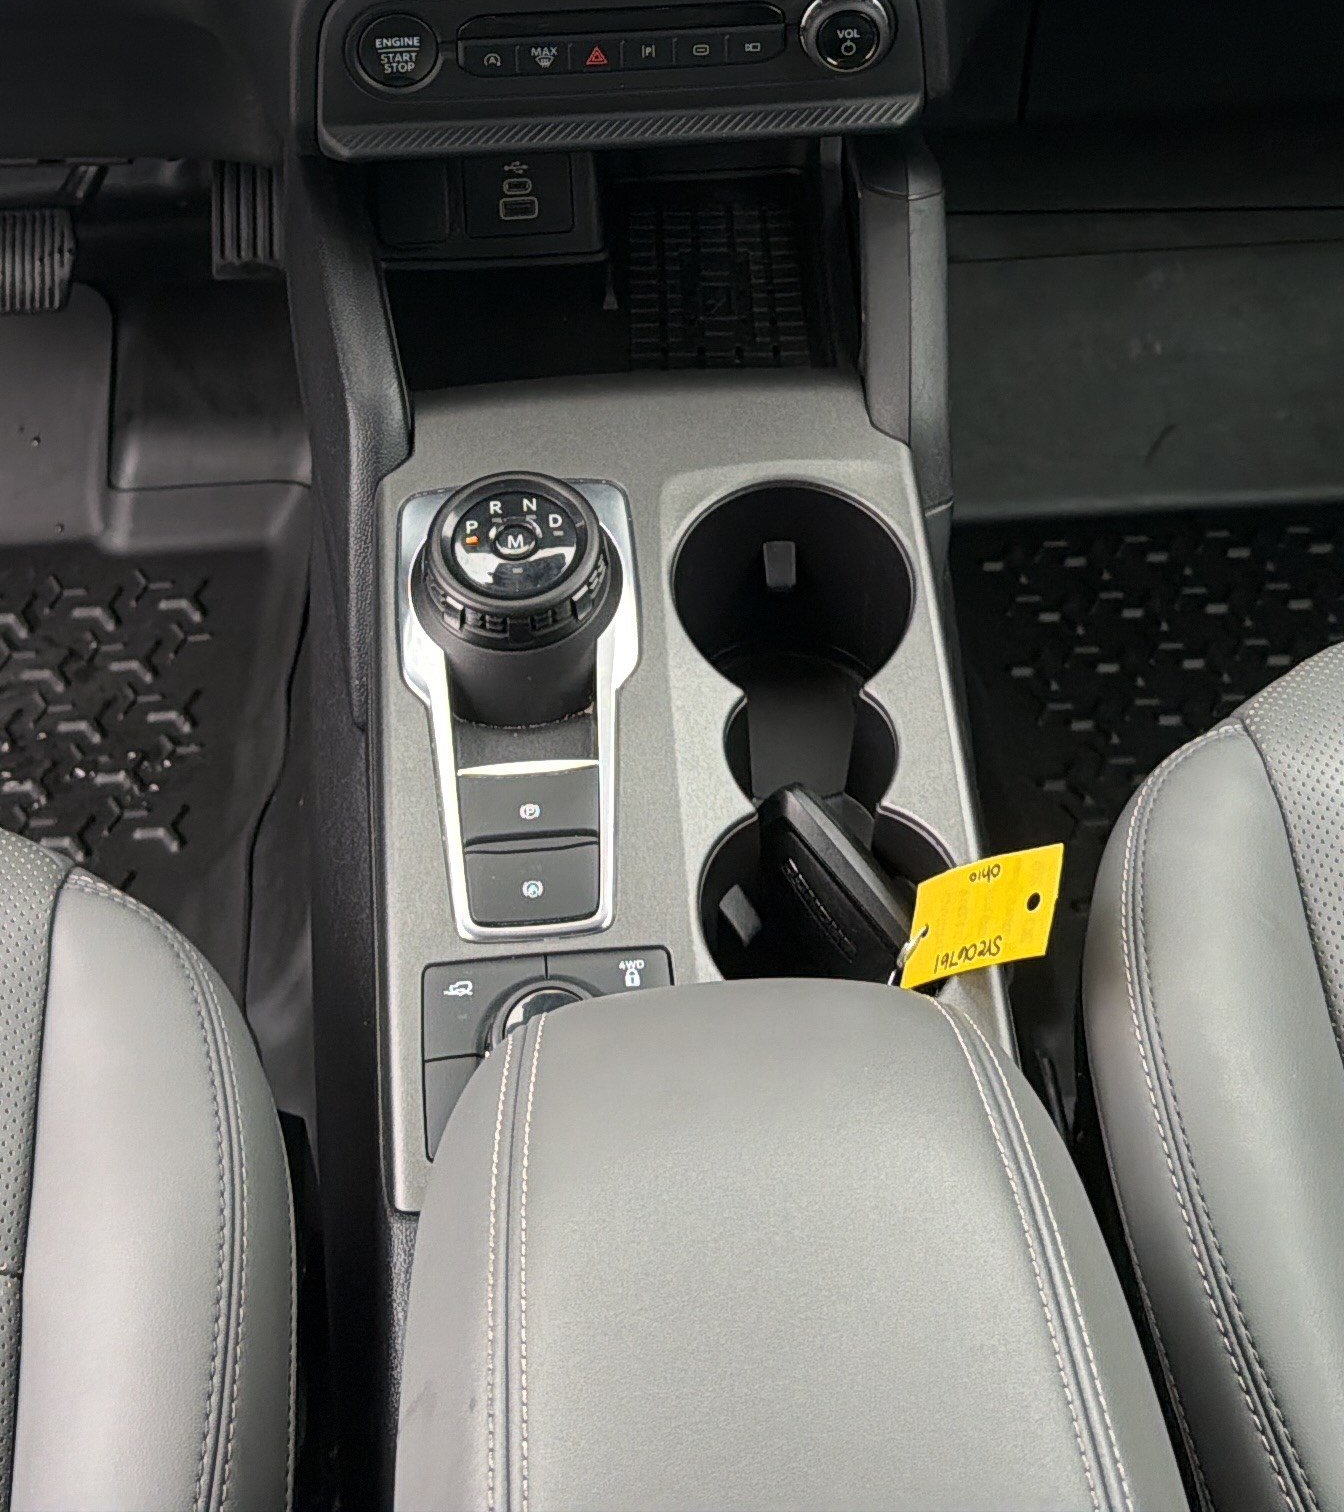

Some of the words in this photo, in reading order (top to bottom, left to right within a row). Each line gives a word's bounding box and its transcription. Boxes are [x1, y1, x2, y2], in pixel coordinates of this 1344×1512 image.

[836, 28, 861, 41] VOL
[375, 36, 421, 50] ENGINE
[379, 52, 418, 65] START
[531, 46, 558, 58] MAX
[383, 62, 416, 74] STOP
[488, 500, 503, 516] R
[522, 498, 538, 512] N
[465, 520, 479, 535] P
[548, 513, 563, 529] D
[506, 534, 525, 550] M
[618, 959, 645, 970] 4WD
